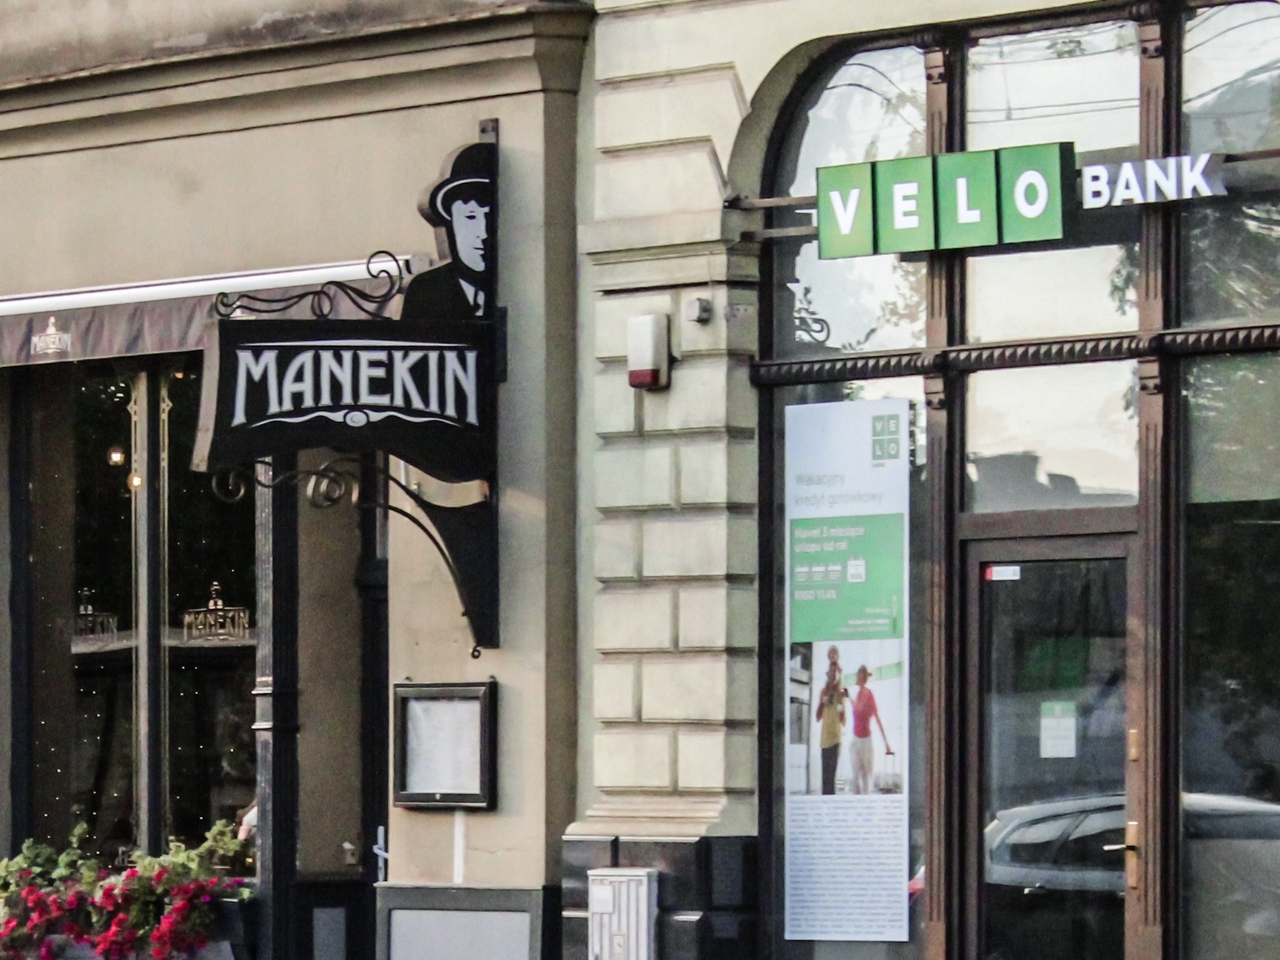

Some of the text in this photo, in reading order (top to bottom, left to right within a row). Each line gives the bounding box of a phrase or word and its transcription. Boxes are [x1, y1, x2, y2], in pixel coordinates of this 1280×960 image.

[829, 153, 1214, 235] VELO BANK
[231, 350, 479, 427] MANEKIN
